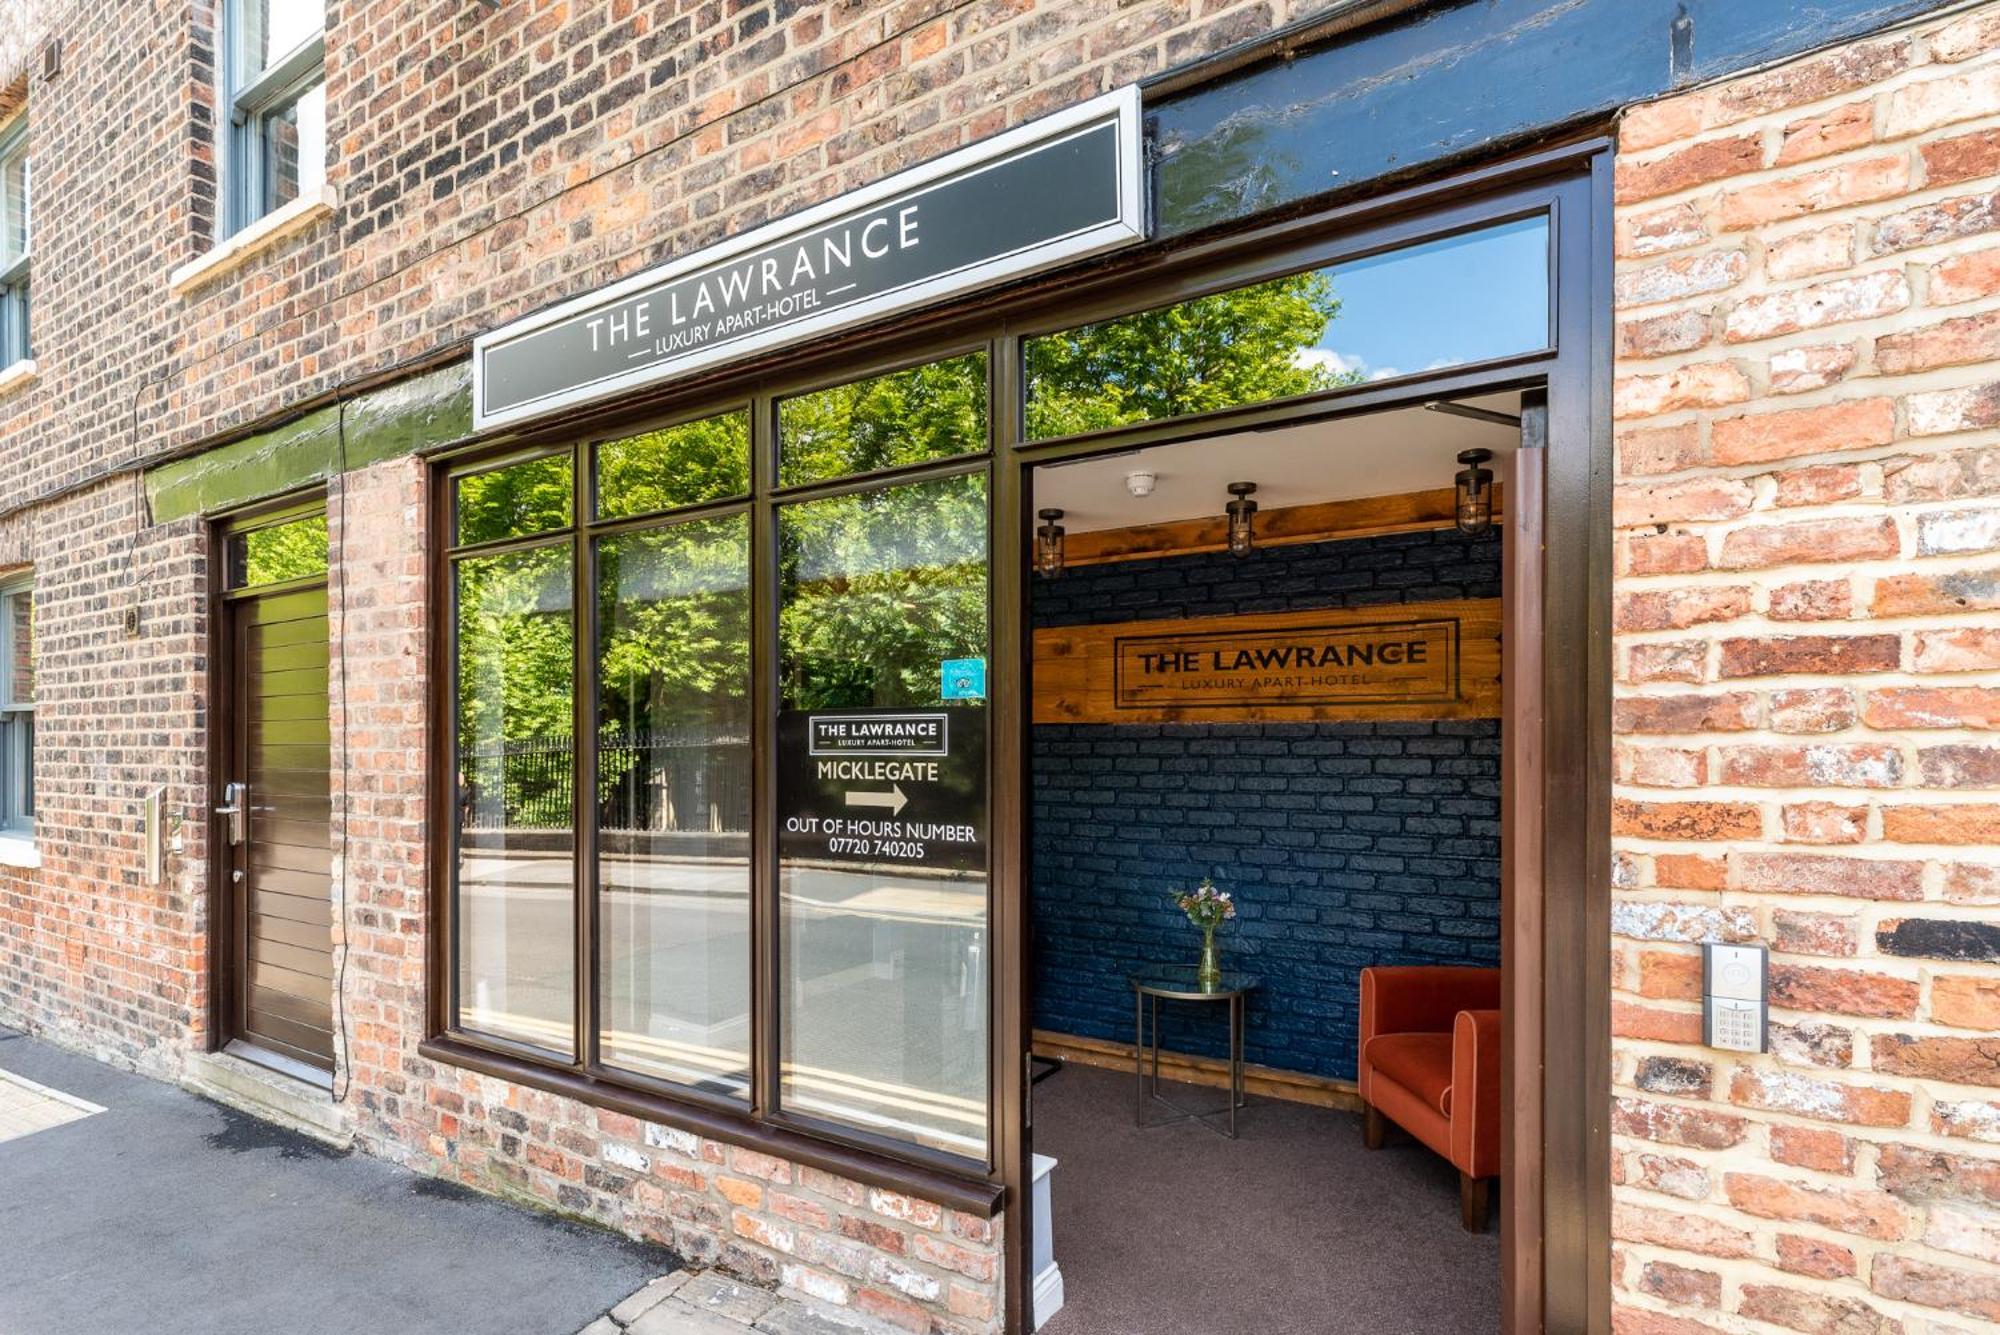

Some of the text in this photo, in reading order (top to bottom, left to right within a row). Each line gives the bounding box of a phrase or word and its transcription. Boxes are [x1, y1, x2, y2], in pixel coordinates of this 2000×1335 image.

[586, 205, 919, 351] THE LAWRANCE
[655, 288, 821, 355] LUXURY APART-HOTEL
[1138, 641, 1428, 675] THE LAWRANCE
[1181, 674, 1370, 690] LUXURY APART-HOTEL
[818, 723, 937, 737] THE LAWRANCE
[838, 738, 916, 747] LUXURY APART-HOTEL
[818, 761, 938, 782] MICKLEGATE
[787, 817, 976, 842] OUT OF HOURS NUMBER
[829, 837, 925, 858] 07720 740205
